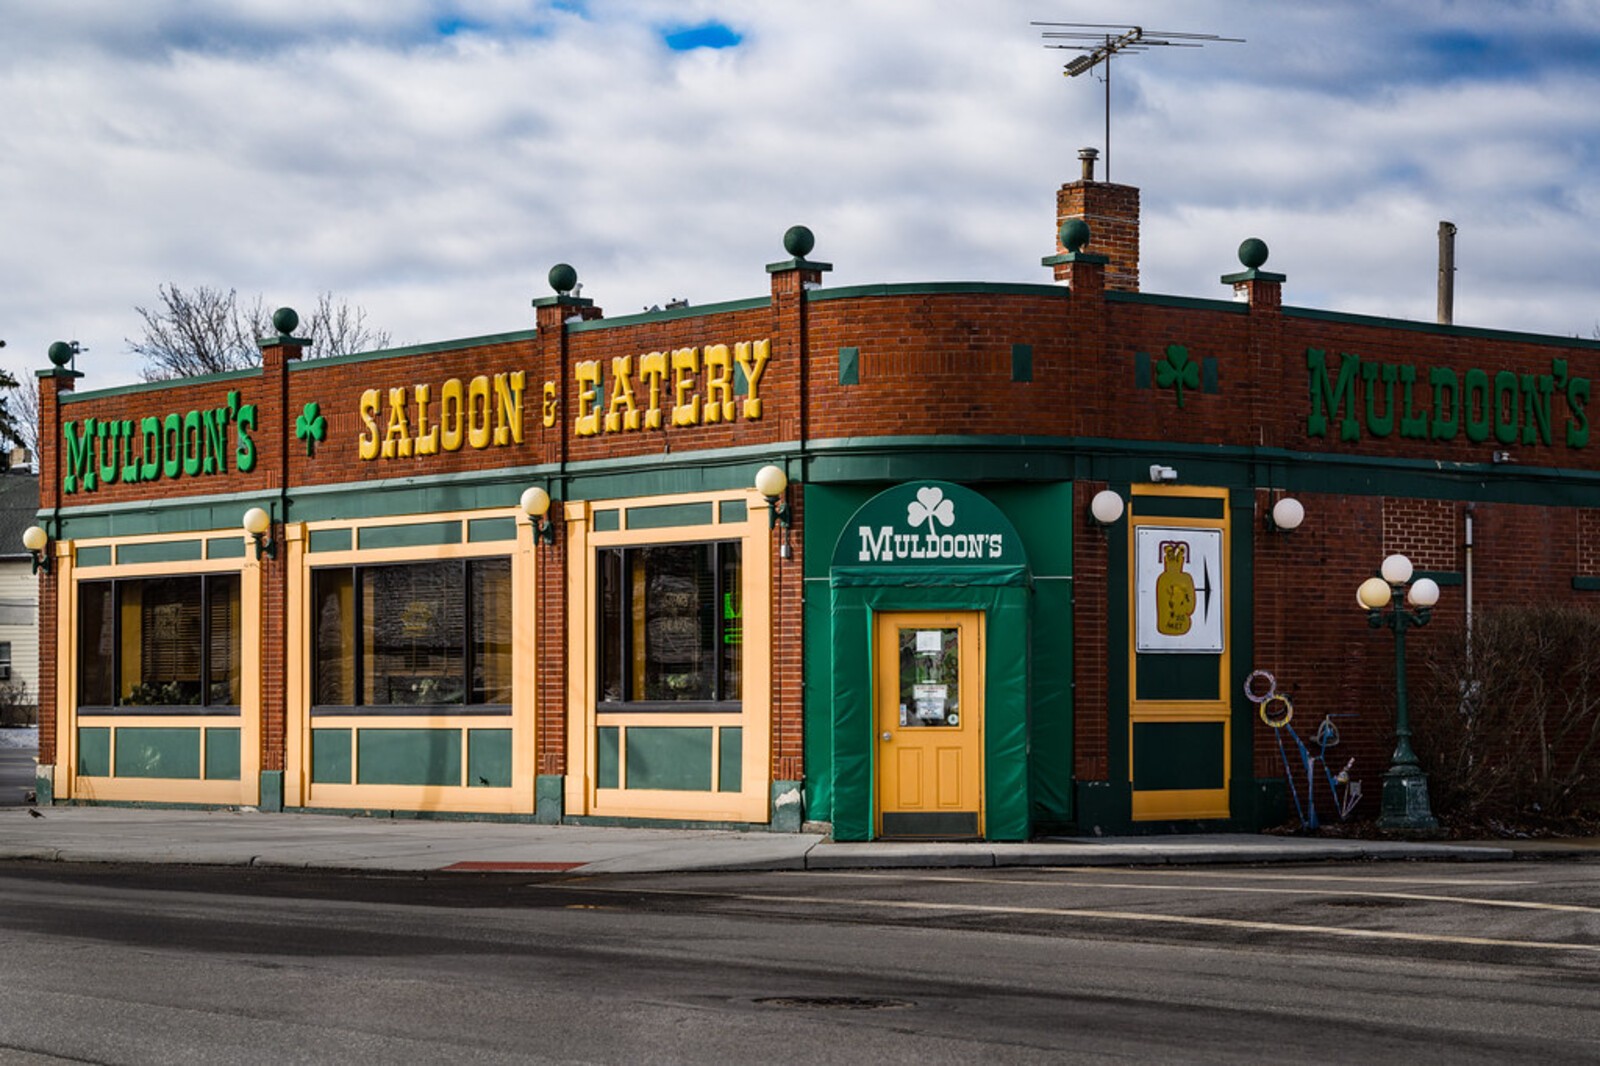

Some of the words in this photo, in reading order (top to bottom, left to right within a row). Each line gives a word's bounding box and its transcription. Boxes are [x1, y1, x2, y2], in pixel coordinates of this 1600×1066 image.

[63, 389, 257, 494] MULDOON'S
[358, 369, 526, 461] SALOON
[543, 380, 557, 428] &
[574, 338, 771, 436] EATERY
[1306, 347, 1591, 449] MULDOON'S
[858, 525, 1003, 562] MULDOON'S
